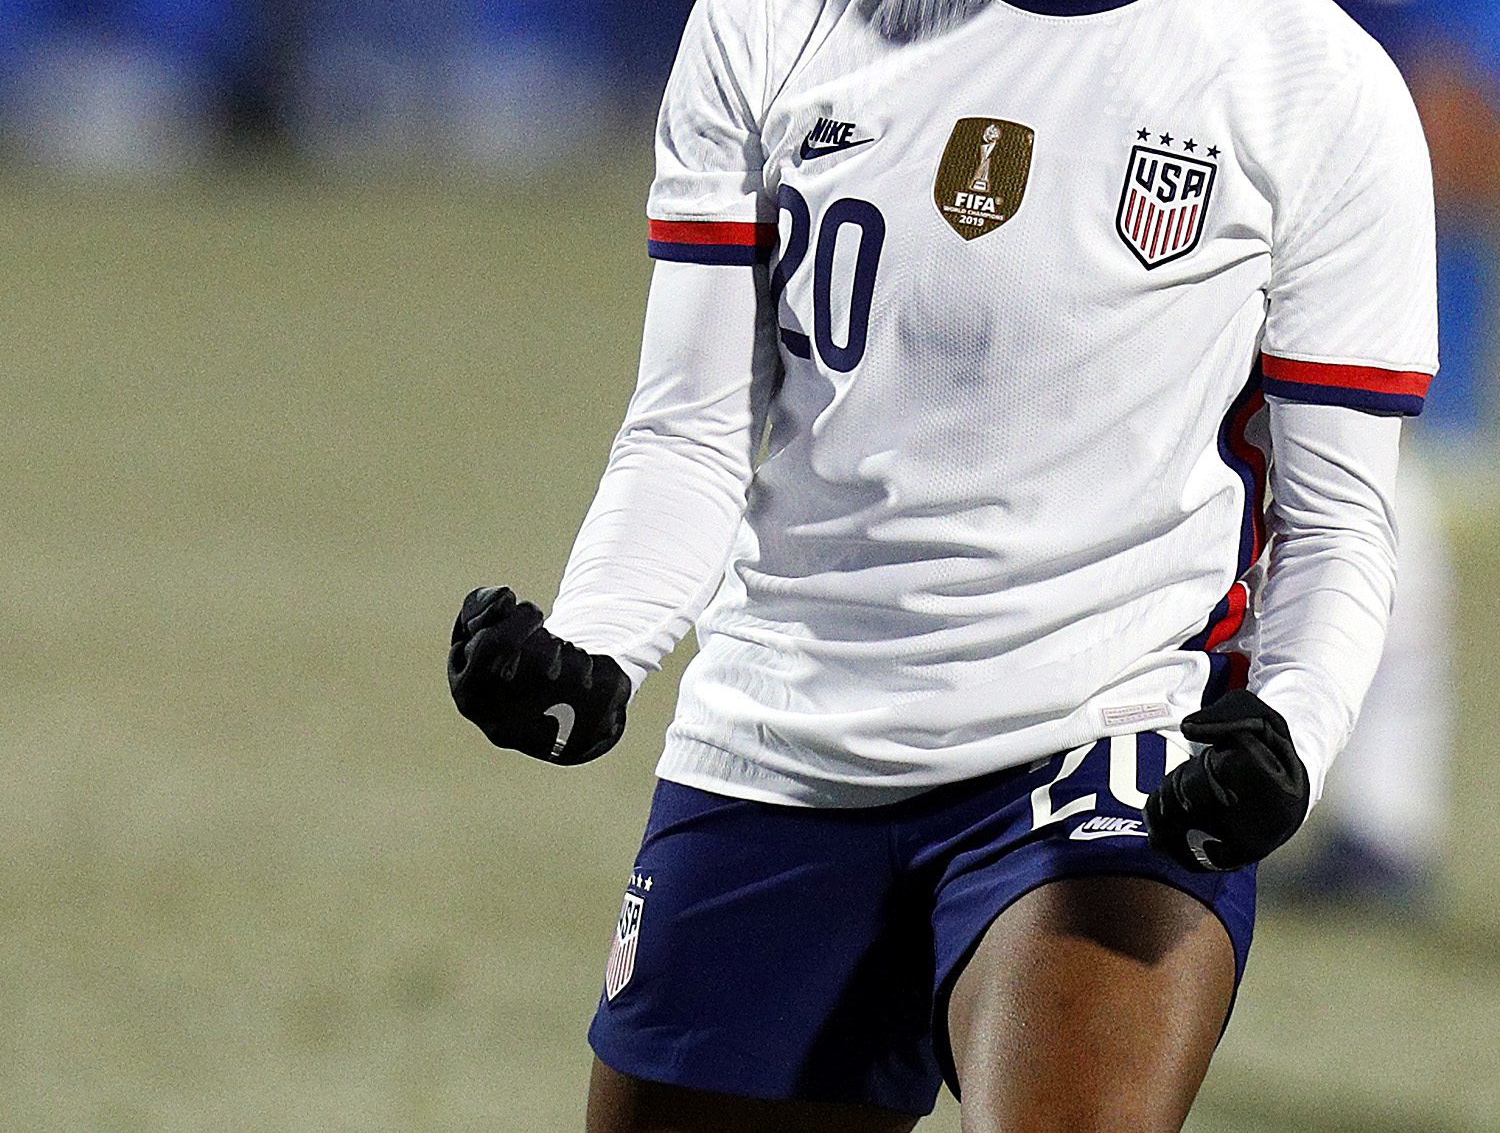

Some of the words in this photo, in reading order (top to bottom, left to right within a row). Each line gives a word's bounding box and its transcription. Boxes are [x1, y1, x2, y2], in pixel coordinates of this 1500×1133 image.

[809, 117, 856, 145] NIKE
[1135, 157, 1206, 203] USA
[943, 205, 967, 214] WORLD
[967, 209, 1004, 221] CHAMPIONS
[954, 192, 996, 213] FIFA
[959, 214, 985, 227] 2019
[771, 183, 886, 373] 20
[1083, 816, 1143, 831] NIKE
